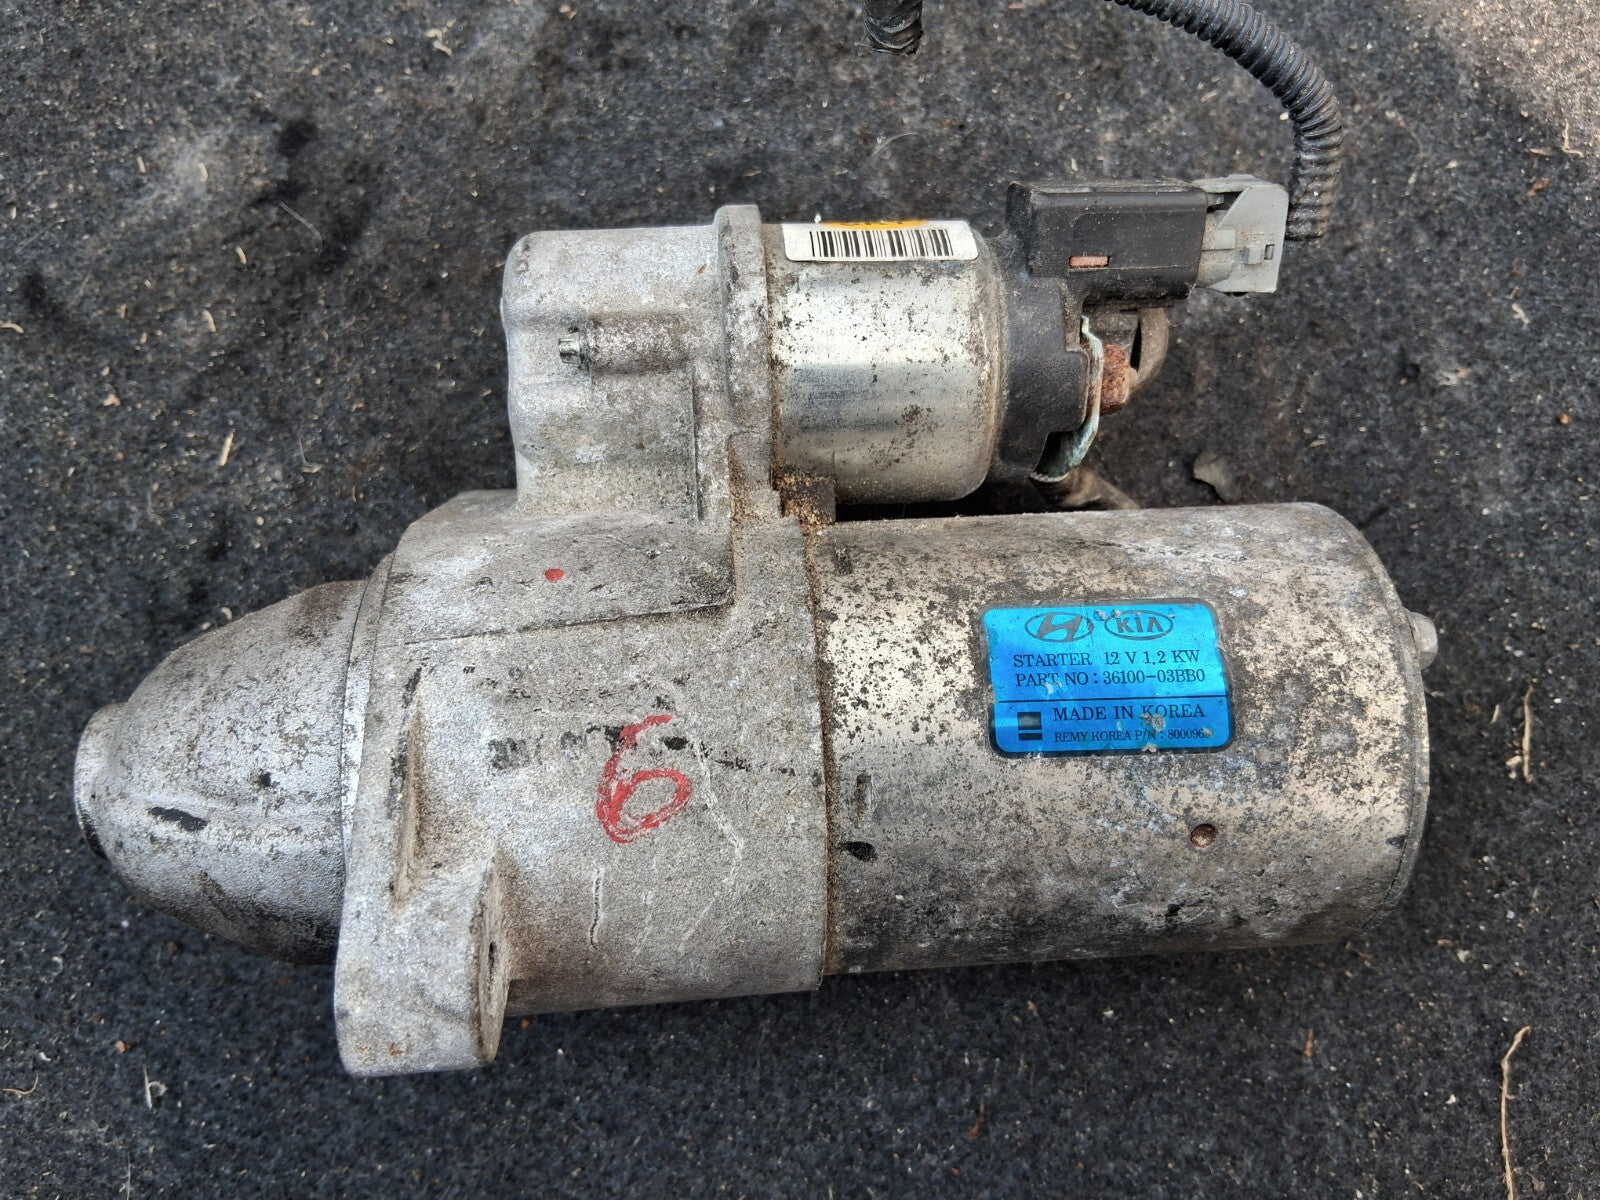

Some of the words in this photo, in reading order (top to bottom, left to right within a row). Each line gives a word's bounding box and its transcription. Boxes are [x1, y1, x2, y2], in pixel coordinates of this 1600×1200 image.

[1116, 616, 1162, 635] KIA
[1013, 652, 1092, 667] STARTER
[1104, 651, 1120, 665] 12
[1124, 651, 1137, 664] V
[1143, 650, 1166, 666] 1.2
[1173, 649, 1200, 663] KW
[1016, 672, 1059, 687] PART
[1103, 668, 1205, 685] 36100-03BB0
[1053, 706, 1107, 721] MADE
[1114, 705, 1134, 719] IN
[1142, 703, 1205, 719] KOREA
[1055, 730, 1091, 743] REMY
[1092, 730, 1132, 742] KOREA
